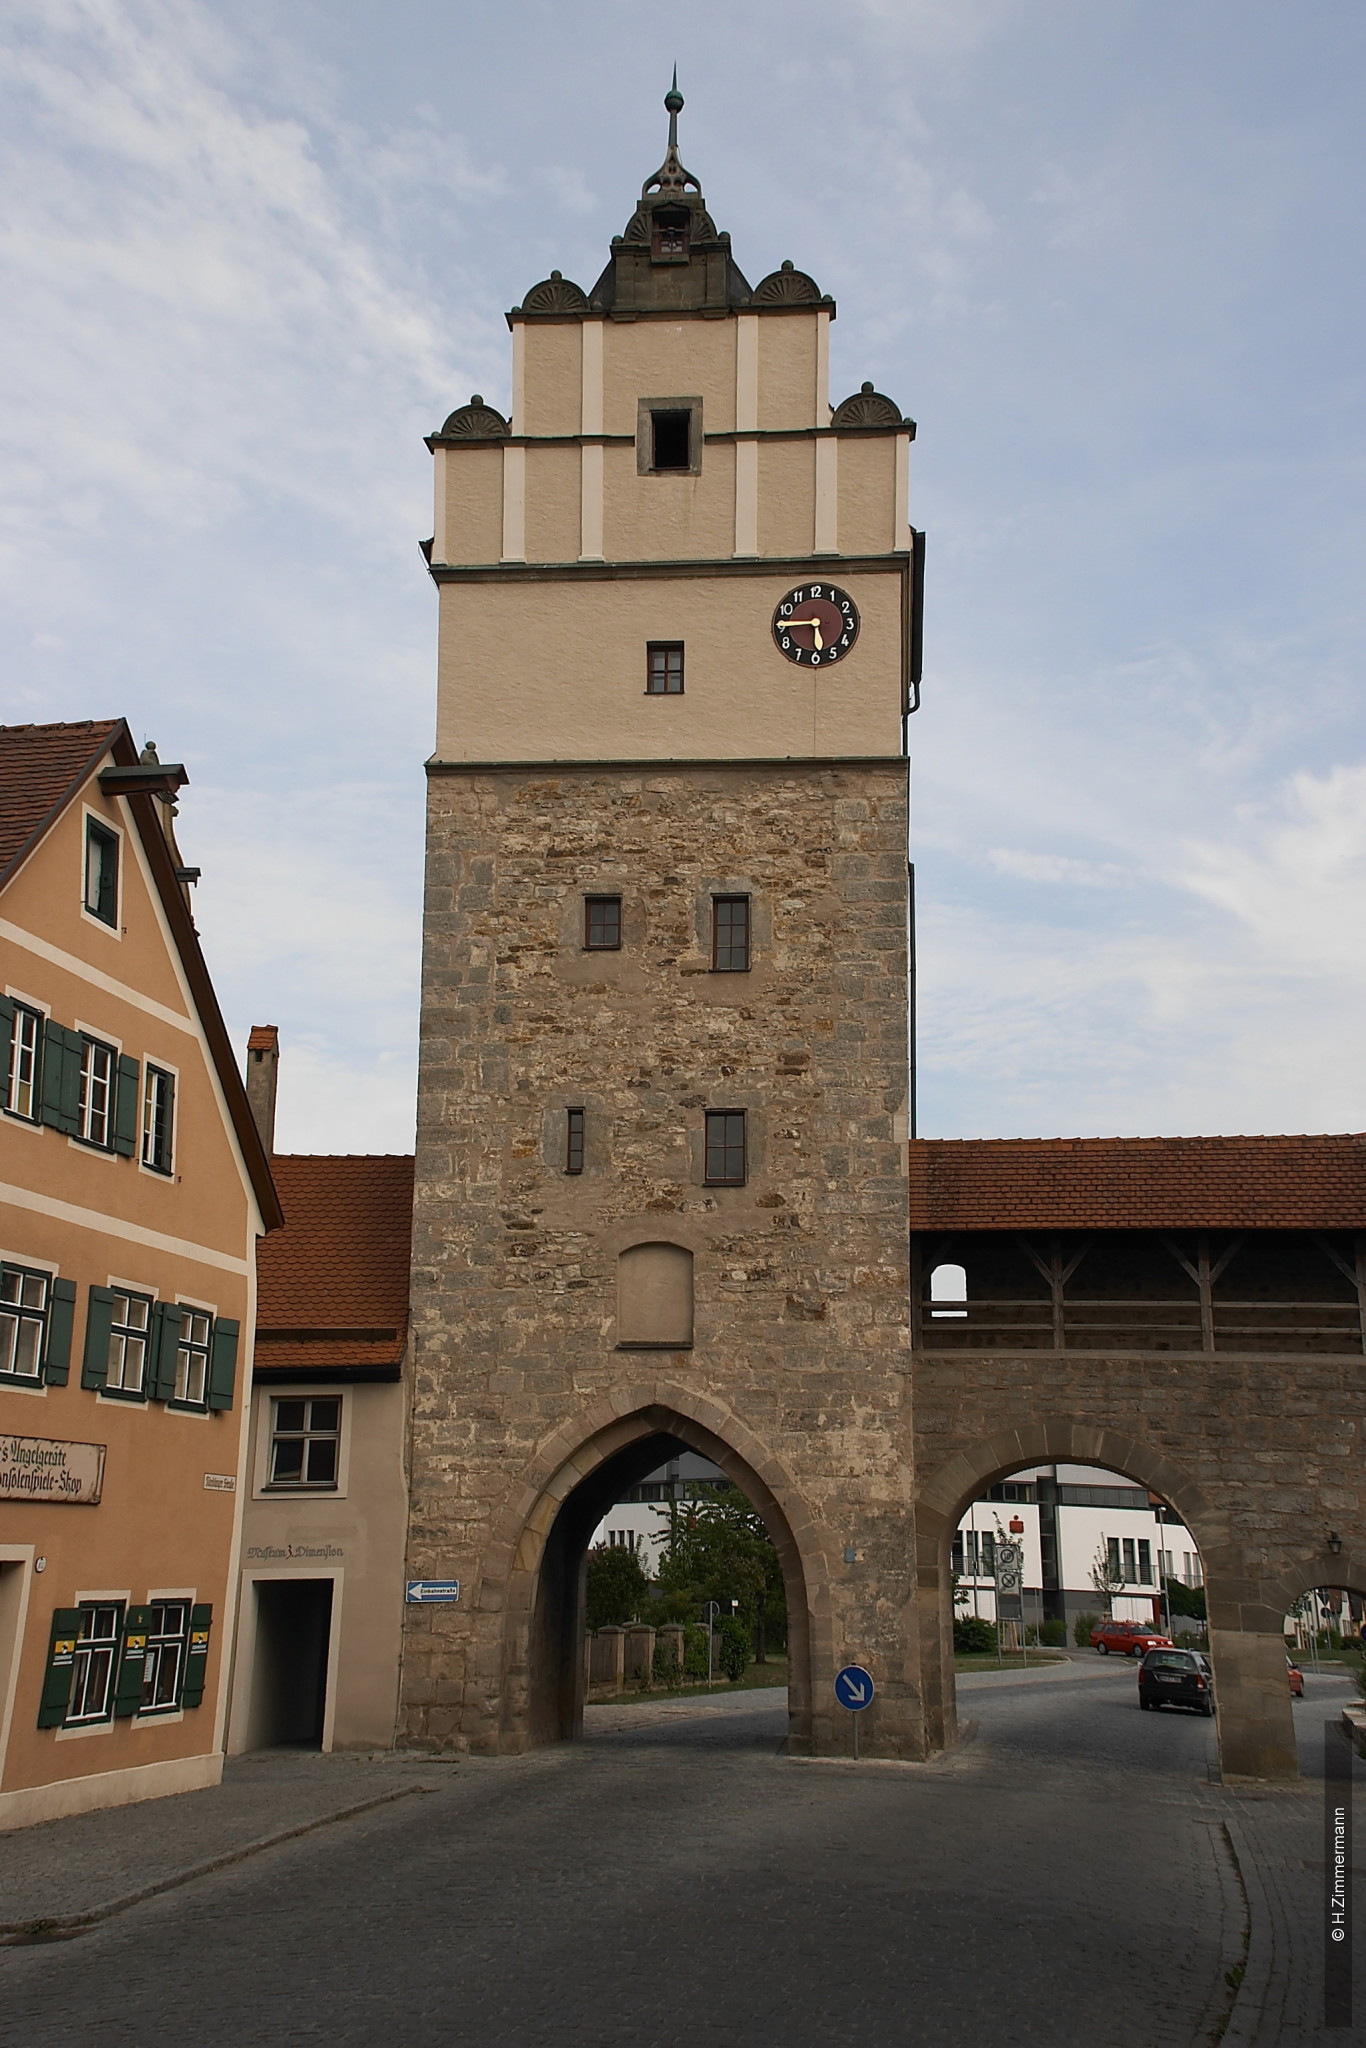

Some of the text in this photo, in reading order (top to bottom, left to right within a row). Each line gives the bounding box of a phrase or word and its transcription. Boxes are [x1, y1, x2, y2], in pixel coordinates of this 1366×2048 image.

[793, 591, 803, 602] 11
[810, 585, 822, 598] 12
[830, 590, 835, 602] 1
[780, 603, 793, 615] 10
[841, 601, 850, 613] 2
[846, 618, 854, 630] 3
[782, 636, 790, 649] 8
[841, 634, 849, 646] 4
[795, 648, 802, 661] 7
[811, 651, 820, 664] 6
[829, 647, 837, 659] 5
[295, 1545, 345, 1560] Dimension
